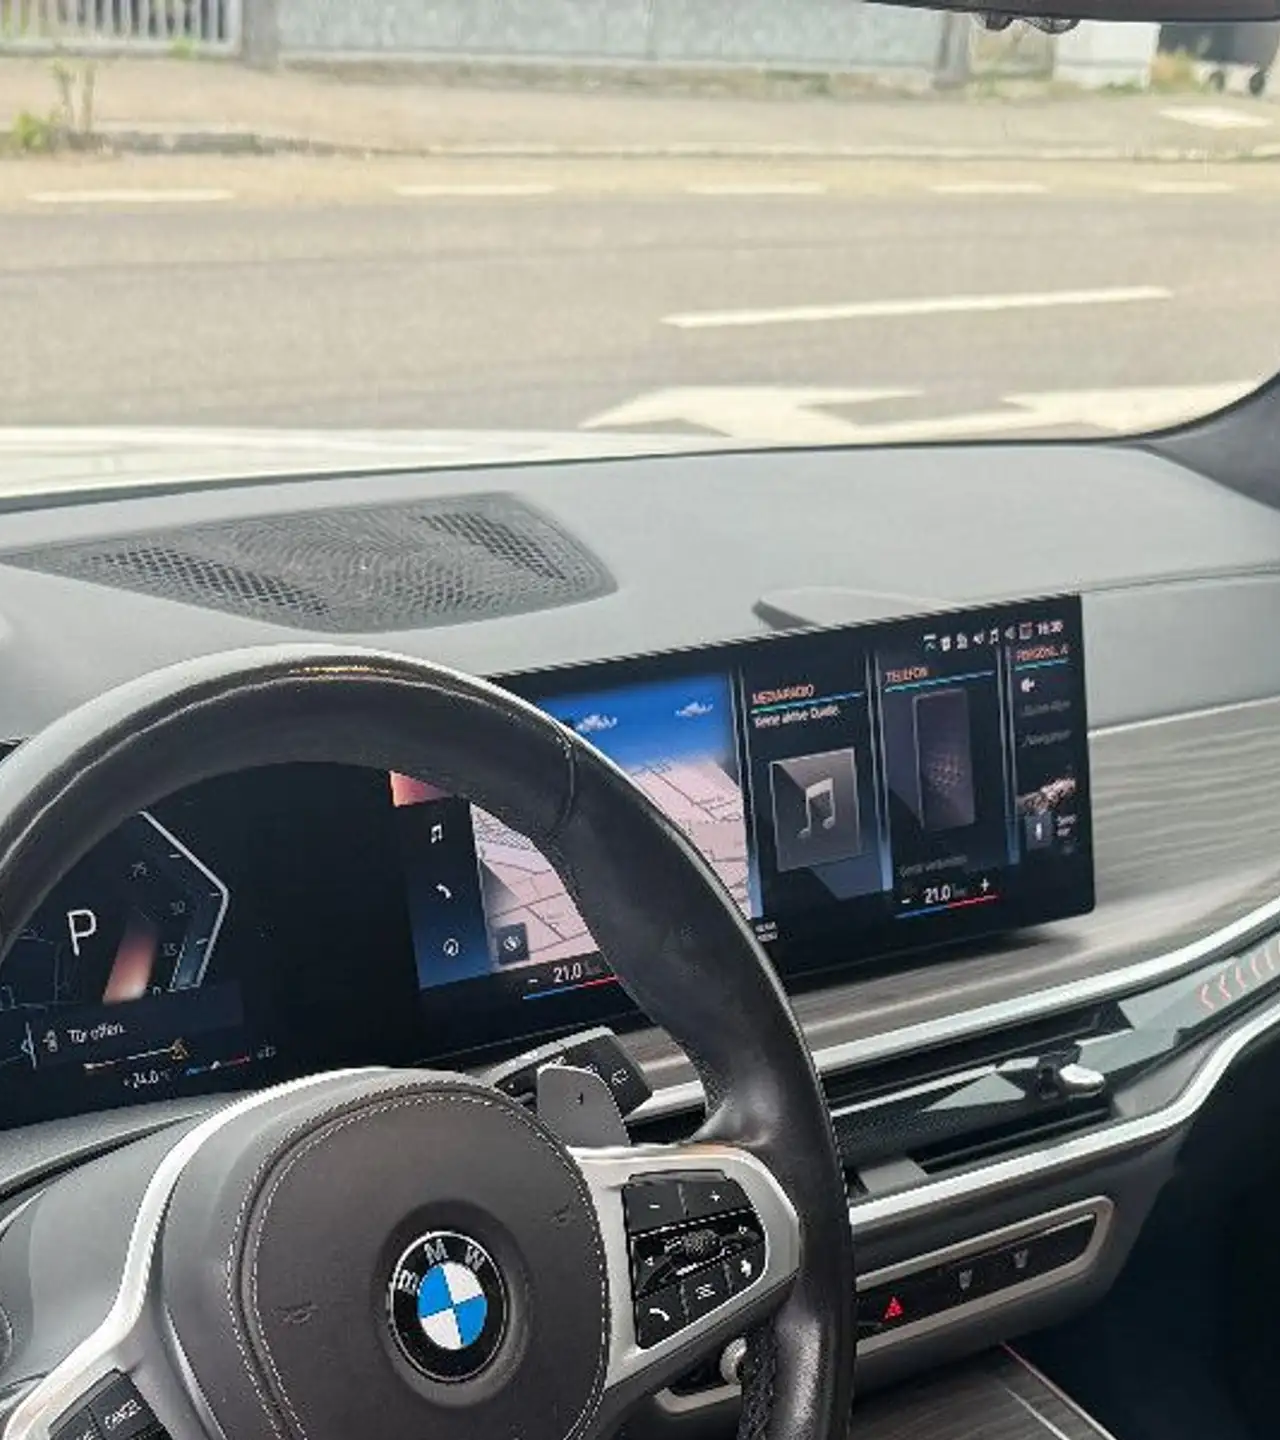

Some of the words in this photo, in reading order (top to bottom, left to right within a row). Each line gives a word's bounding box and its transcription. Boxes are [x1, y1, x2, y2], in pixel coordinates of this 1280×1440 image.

[67, 908, 97, 956] P
[552, 963, 582, 985] 21.0
[396, 1238, 487, 1297] BMW
